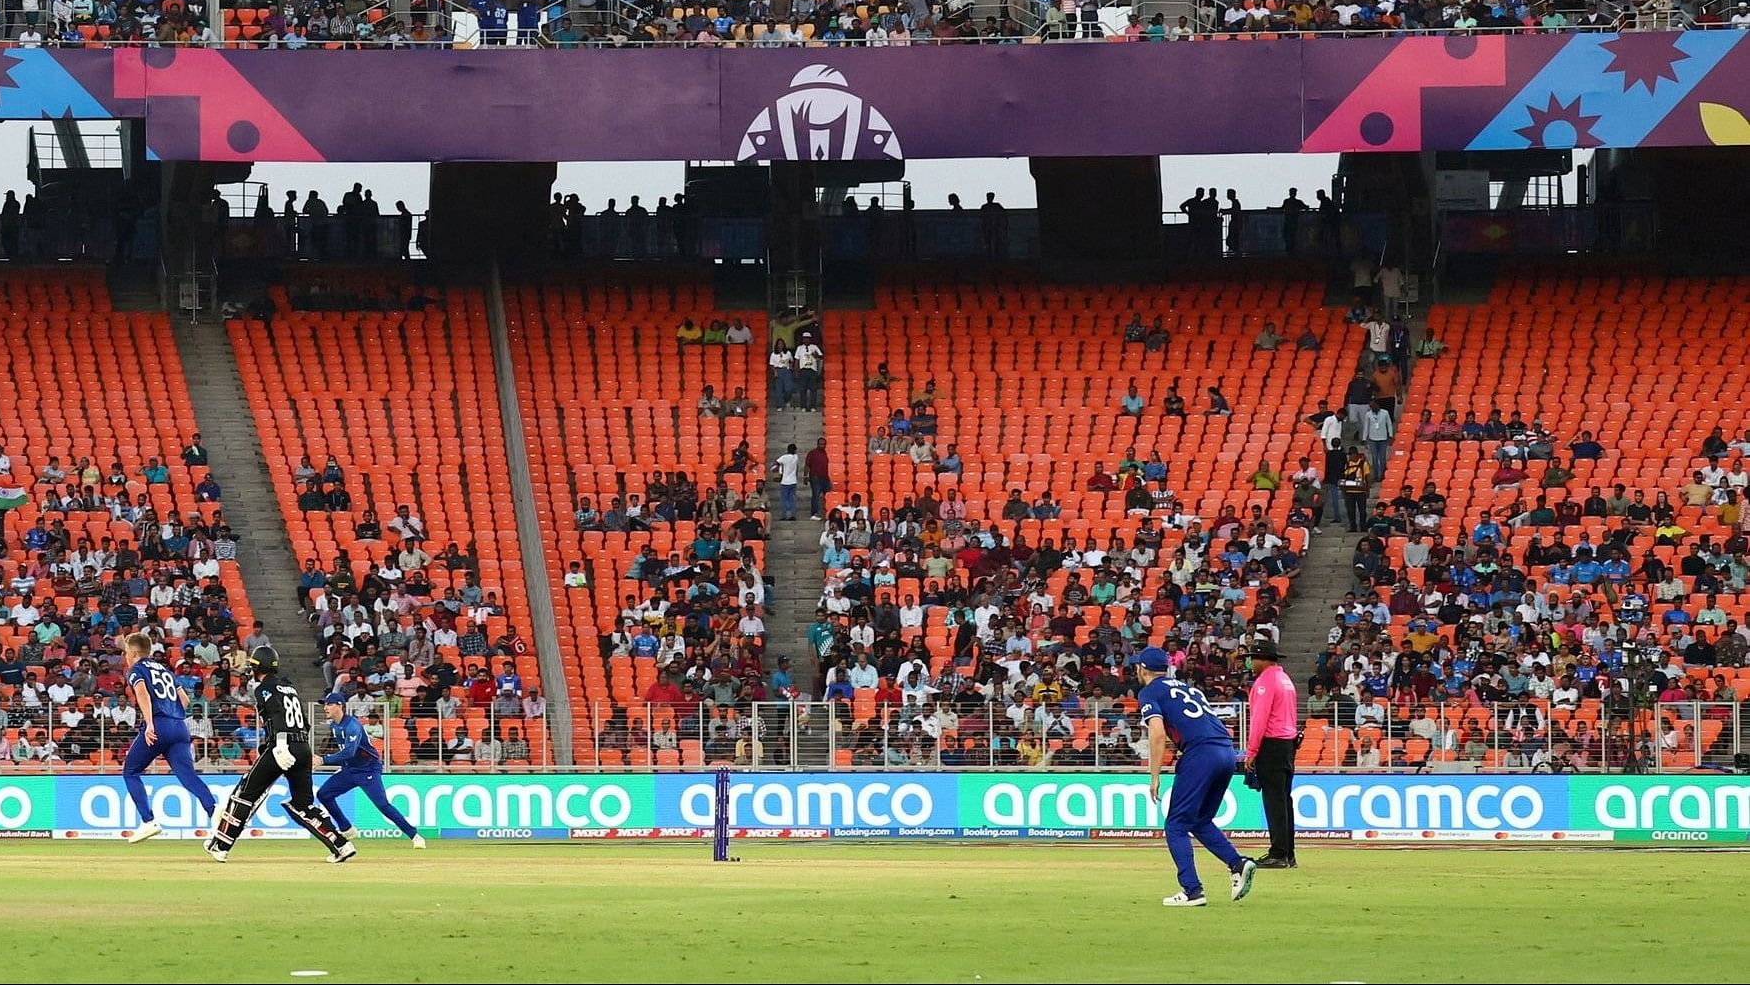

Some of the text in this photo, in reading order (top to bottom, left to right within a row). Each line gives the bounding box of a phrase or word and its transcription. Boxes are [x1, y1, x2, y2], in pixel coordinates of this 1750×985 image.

[515, 640, 525, 653] 6
[150, 669, 177, 702] 58
[1170, 687, 1218, 719] 33
[283, 695, 304, 729] 88
[382, 784, 632, 827] aramco
[680, 783, 933, 826] aramco
[1291, 785, 1544, 829] aramco
[357, 828, 402, 838] ramco
[477, 828, 532, 838] aramco
[700, 829, 740, 837] MF
[746, 829, 784, 837] MRF
[790, 829, 827, 837] MRF
[834, 828, 890, 836] Booking.com
[899, 828, 954, 836] Booking.com
[964, 828, 1018, 837] Booking.com
[1028, 829, 1084, 838] Booking.com
[1099, 830, 1132, 838] IndusInd
[1652, 831, 1708, 840] aramco
